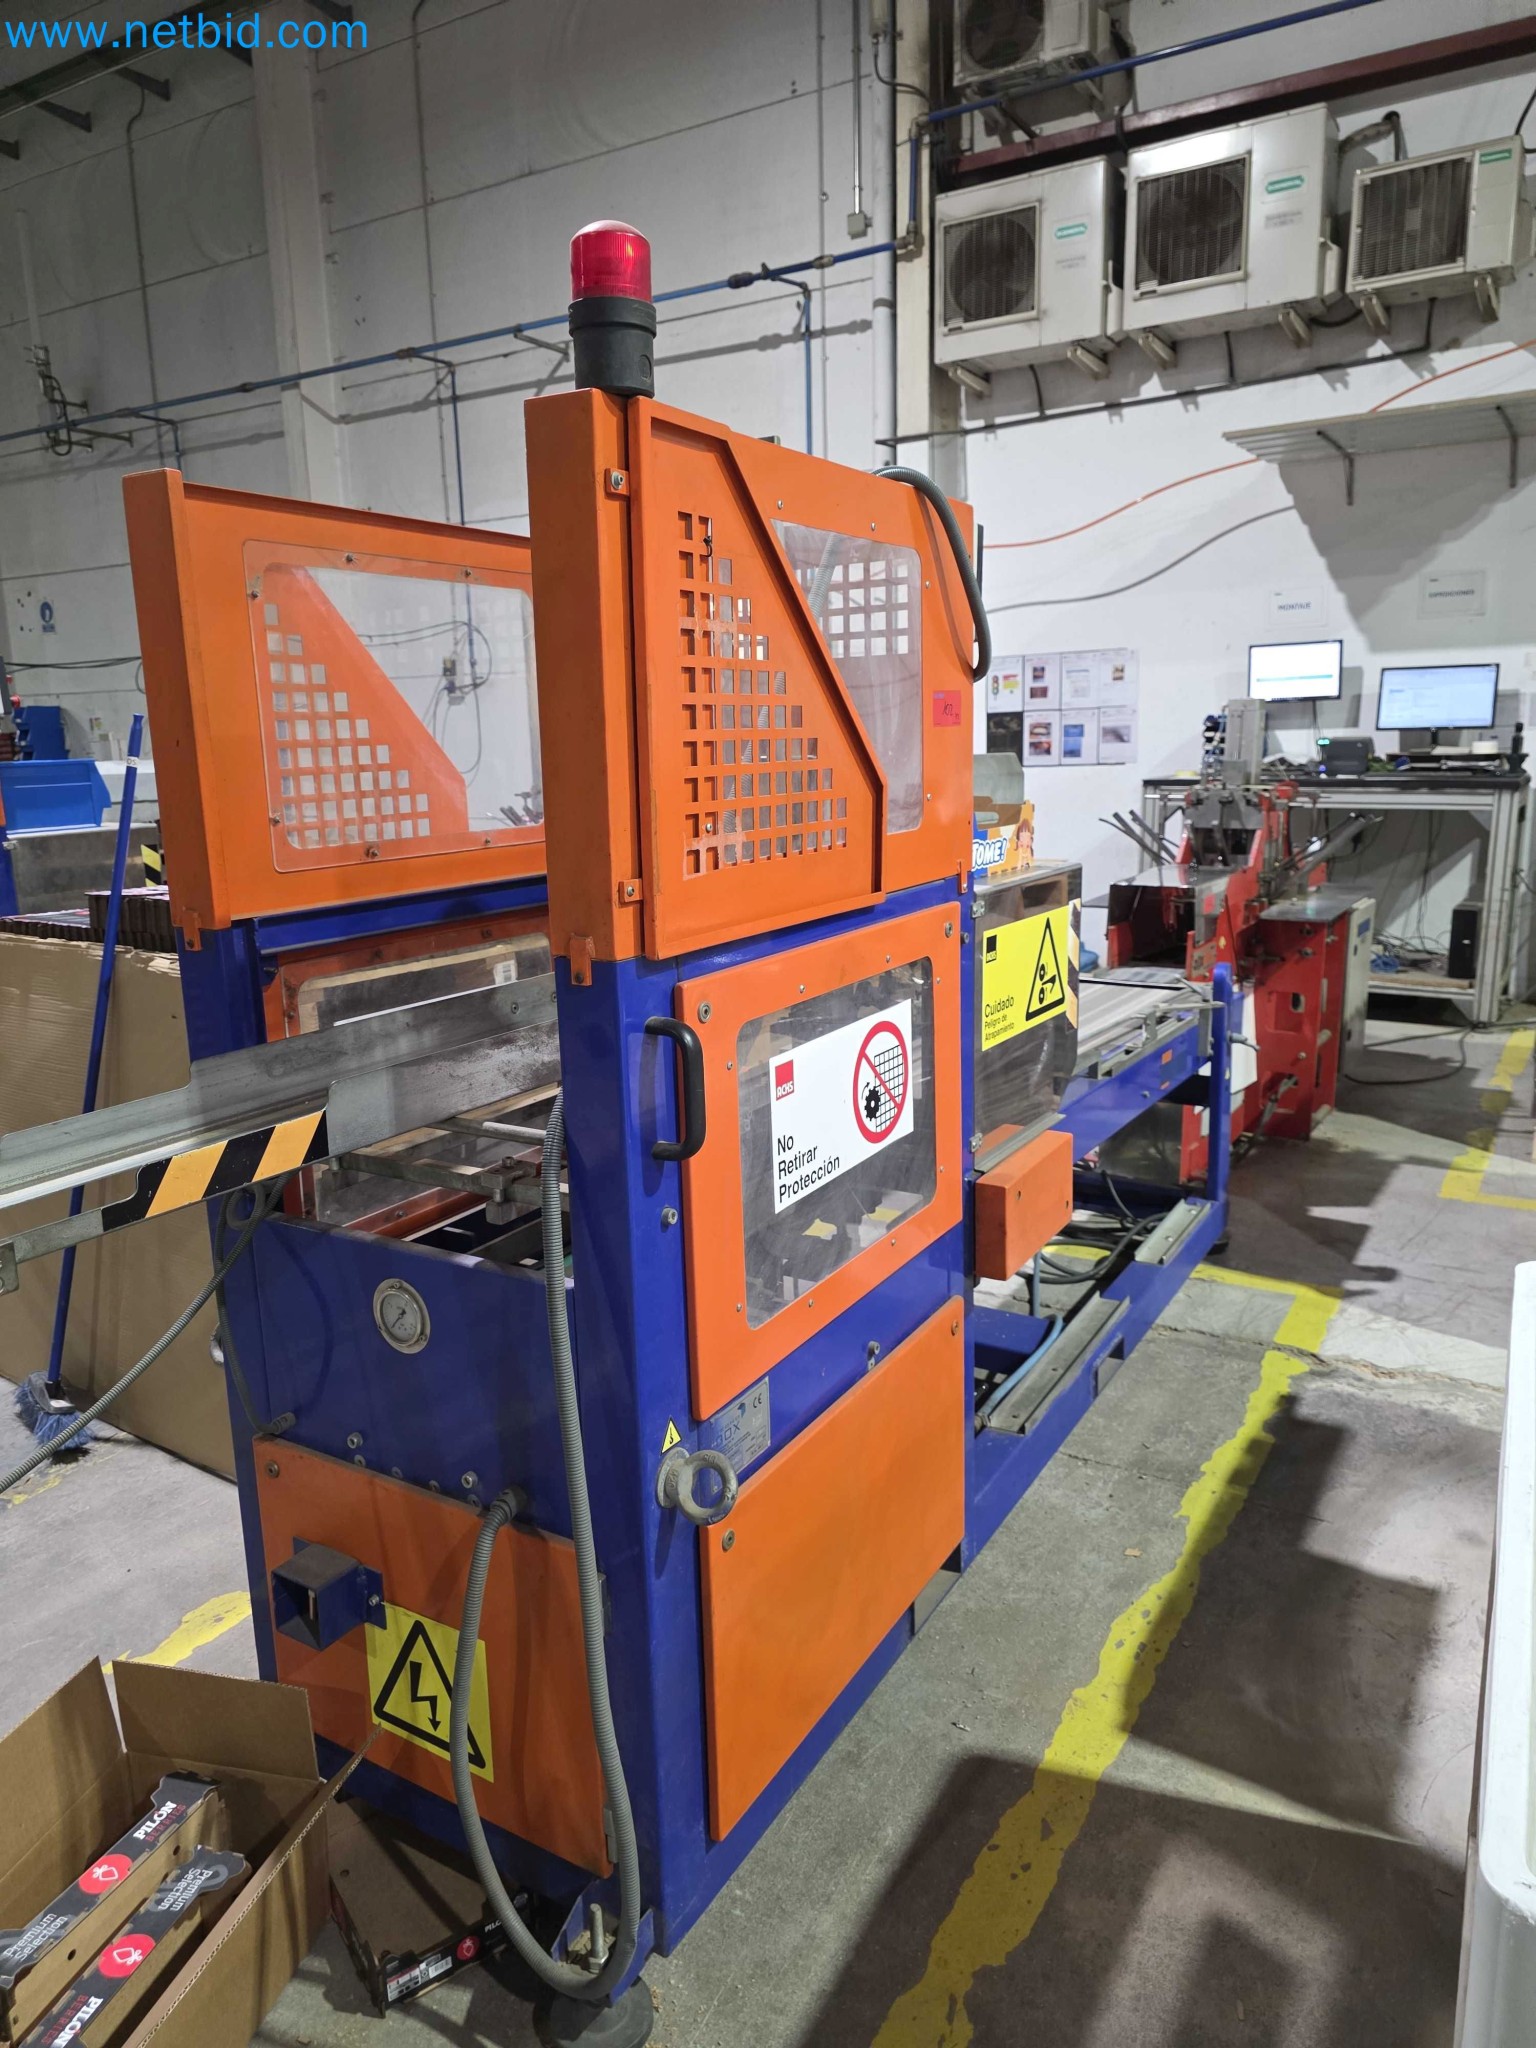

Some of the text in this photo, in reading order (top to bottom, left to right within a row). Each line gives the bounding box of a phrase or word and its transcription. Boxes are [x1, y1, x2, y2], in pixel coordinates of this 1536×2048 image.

[984, 994, 1015, 1018] Cuidado
[777, 1135, 794, 1156] No
[778, 1146, 818, 1180] Retirar
[779, 1155, 840, 1203] Protección
[133, 1801, 177, 1840] PILÓN
[145, 1804, 186, 1842] BERRIES
[158, 1867, 201, 1911] Selection
[170, 1869, 213, 1911] Premium
[3, 1913, 57, 1958] Premium
[15, 1916, 68, 1962] Selection
[484, 1919, 502, 1933] PIL
[41, 1994, 89, 2046] BERRIES
